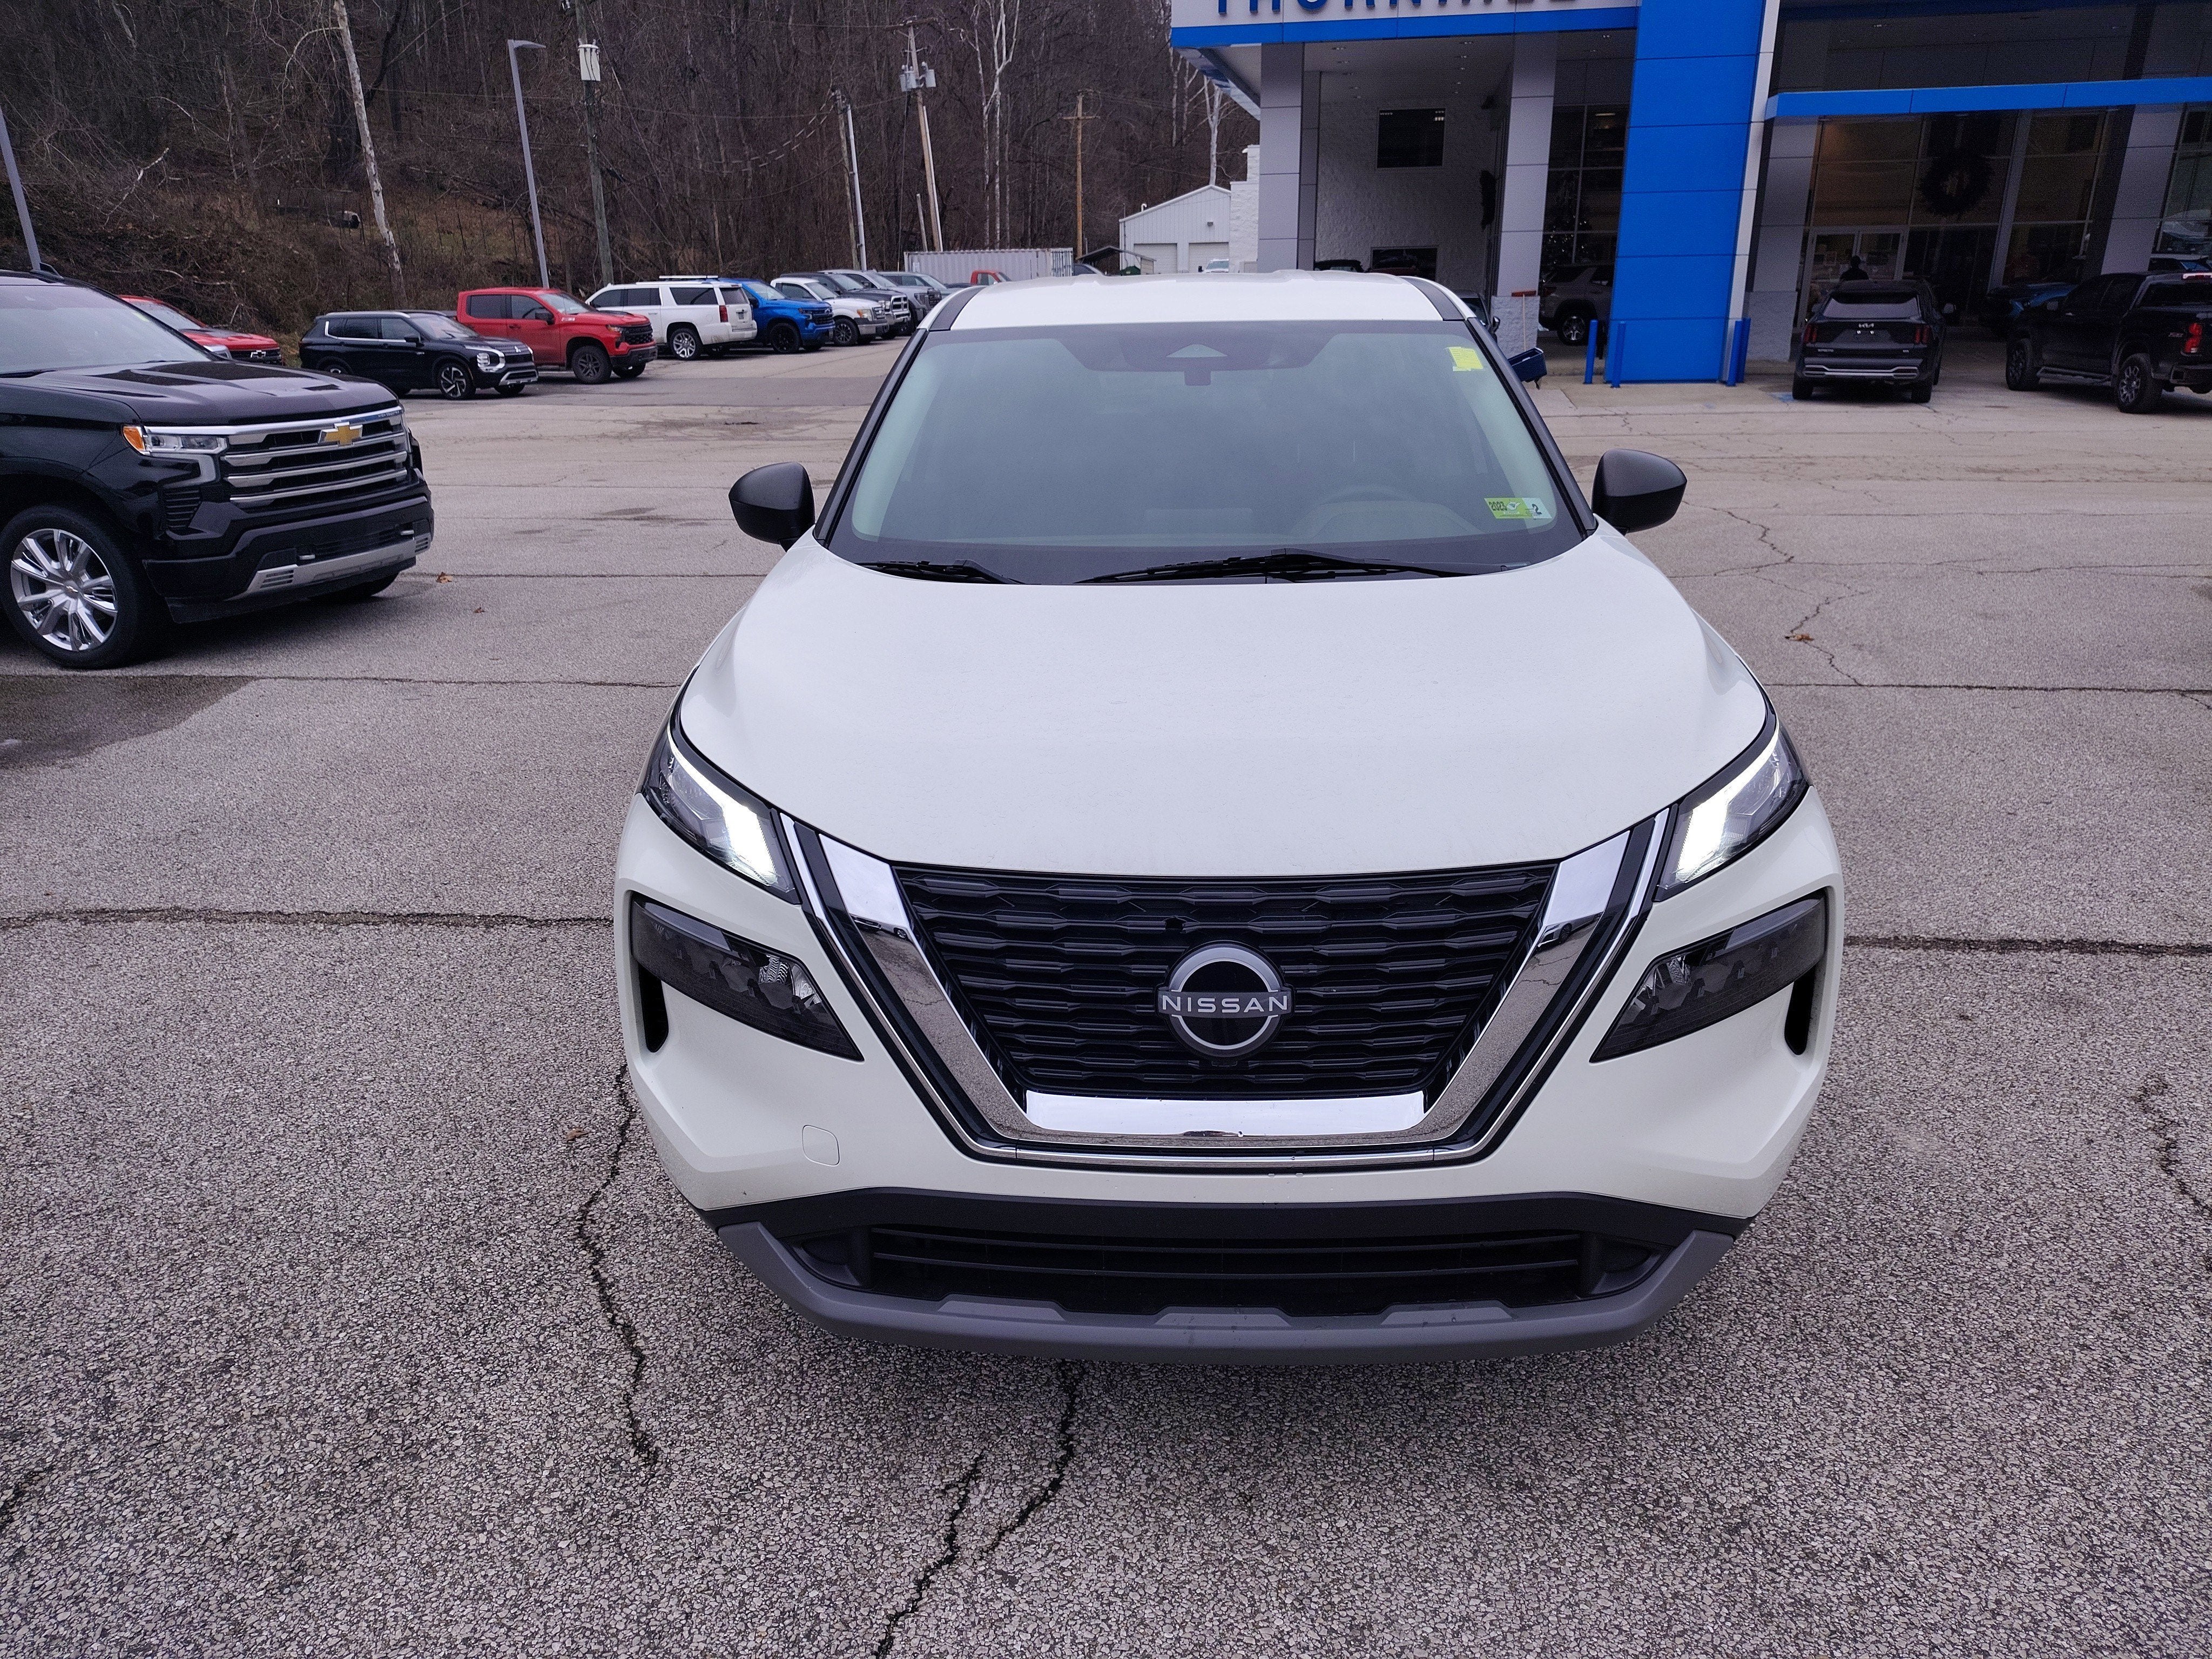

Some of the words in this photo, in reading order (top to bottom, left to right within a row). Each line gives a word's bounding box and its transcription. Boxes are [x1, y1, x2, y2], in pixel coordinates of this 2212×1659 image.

[1488, 501, 1508, 511] 2023
[1532, 503, 1542, 515] 2
[1162, 995, 1287, 1013] NISSAN
